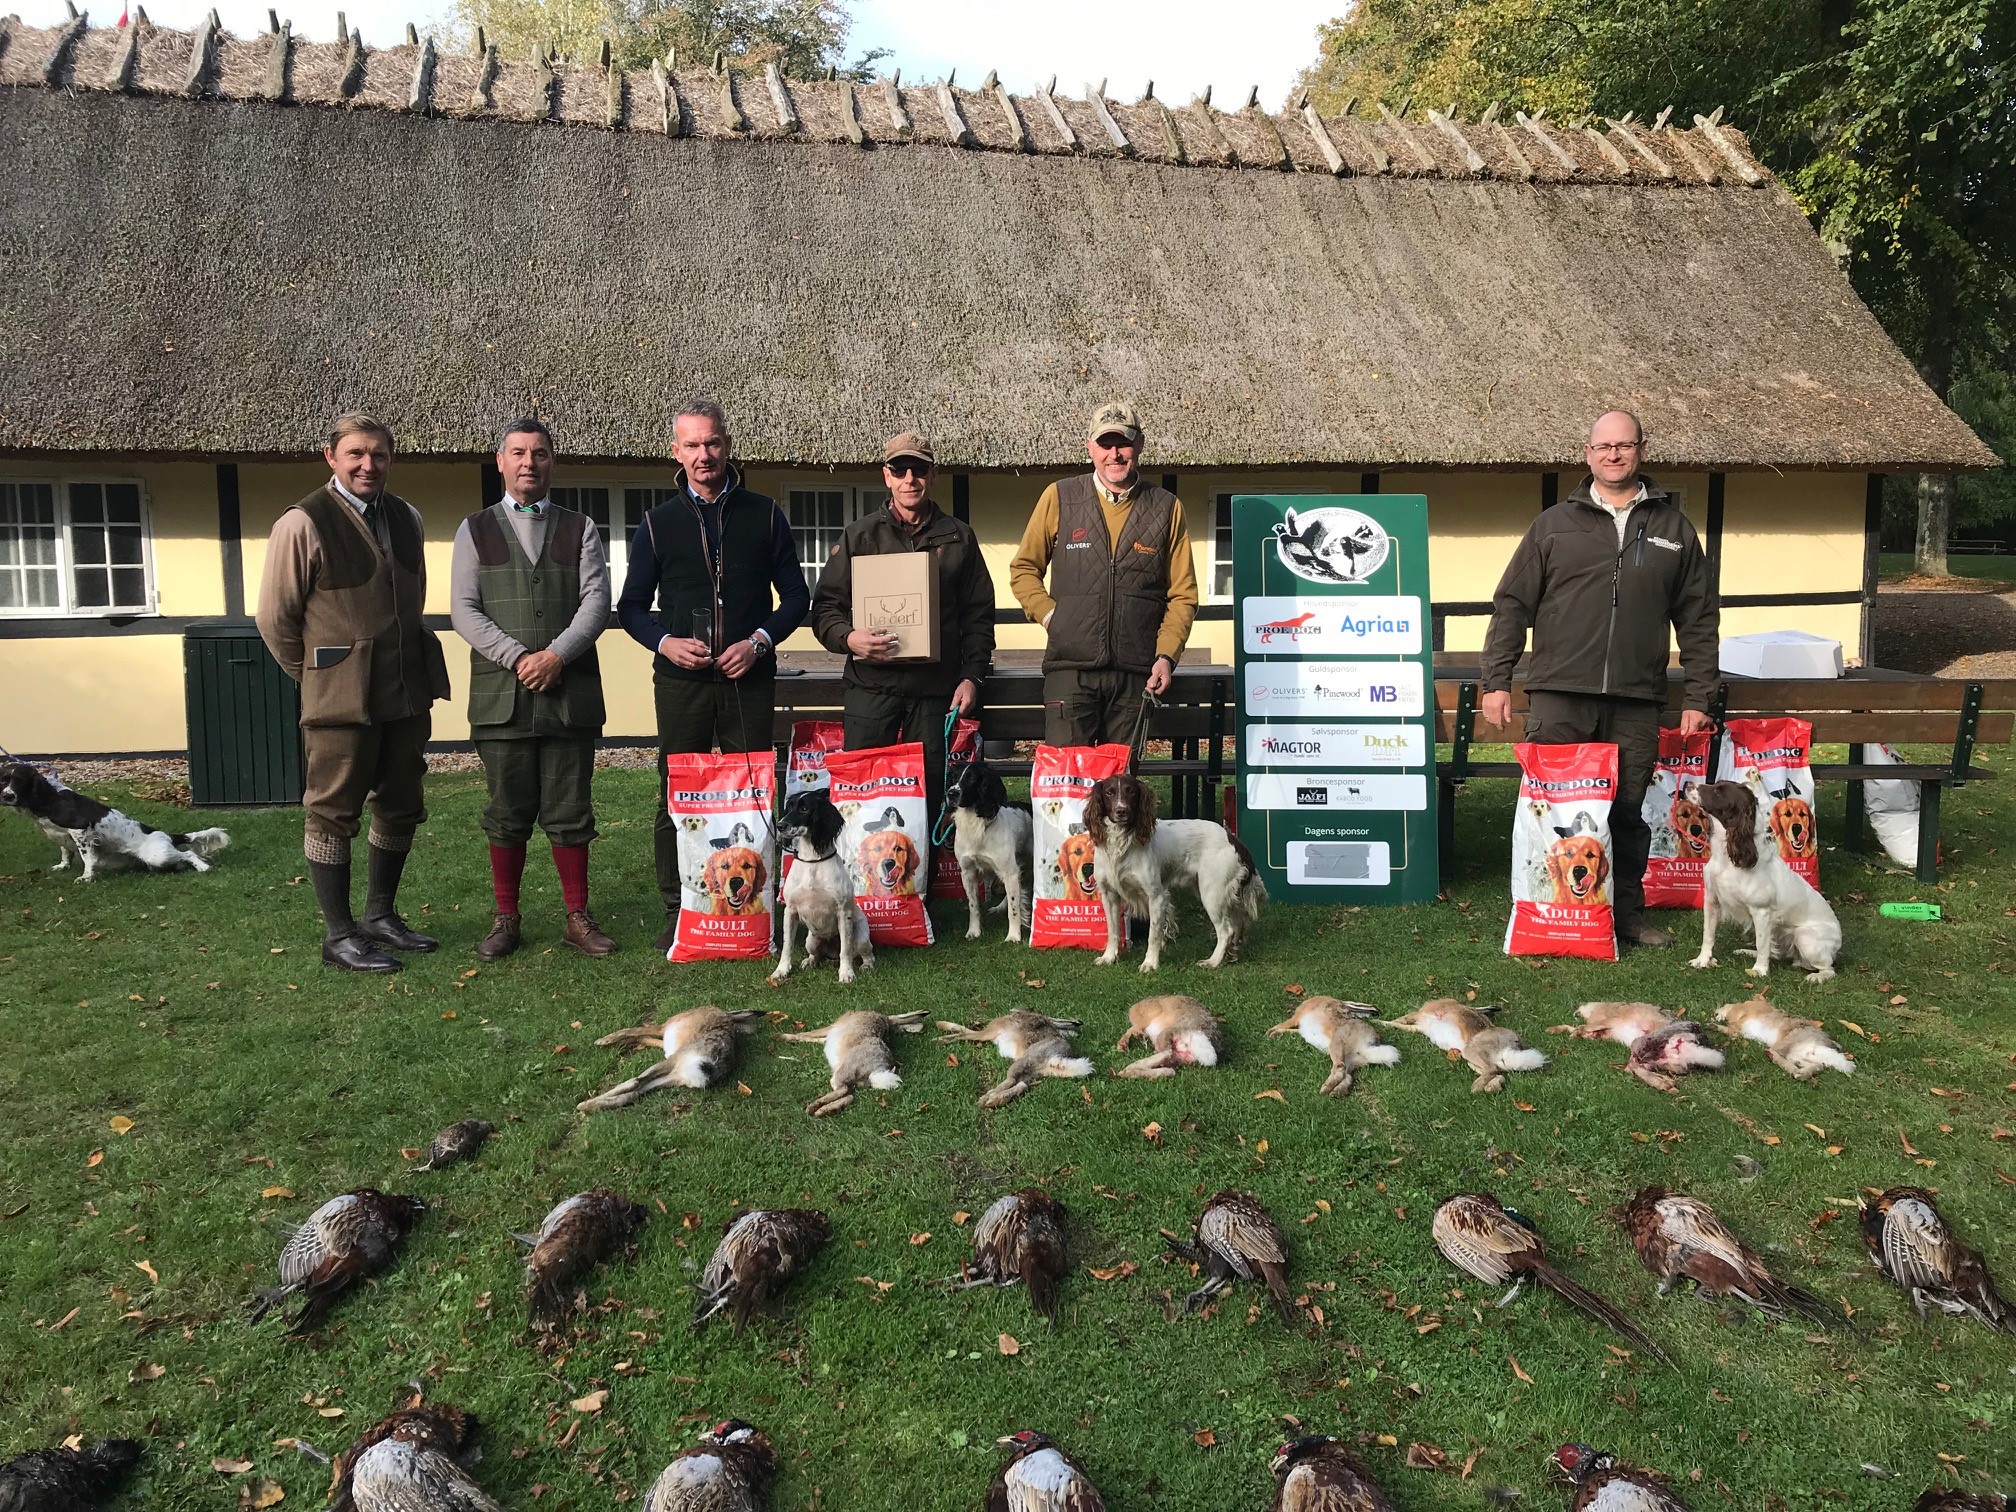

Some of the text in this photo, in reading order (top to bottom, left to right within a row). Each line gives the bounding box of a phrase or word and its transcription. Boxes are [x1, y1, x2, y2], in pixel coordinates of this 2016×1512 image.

[1303, 600, 1359, 608] Hovedsponsor
[1341, 615, 1394, 637] Agria
[1309, 665, 1357, 674] Guldsponsor
[1272, 687, 1306, 695] OLIVERS
[1323, 687, 1361, 698] Pinewood
[1311, 727, 1358, 737] Sølvsponsor
[1363, 735, 1408, 747] Duck
[1268, 742, 1321, 754] MAGTOR
[1306, 778, 1365, 786] Broncesponsor
[1305, 827, 1369, 837] Dagens sponsor
[891, 909, 909, 917] DOG
[1052, 905, 1100, 915] ADULT
[1540, 909, 1591, 920] ADULT
[697, 919, 748, 931] ADULT
[705, 930, 736, 938] FAMILY
